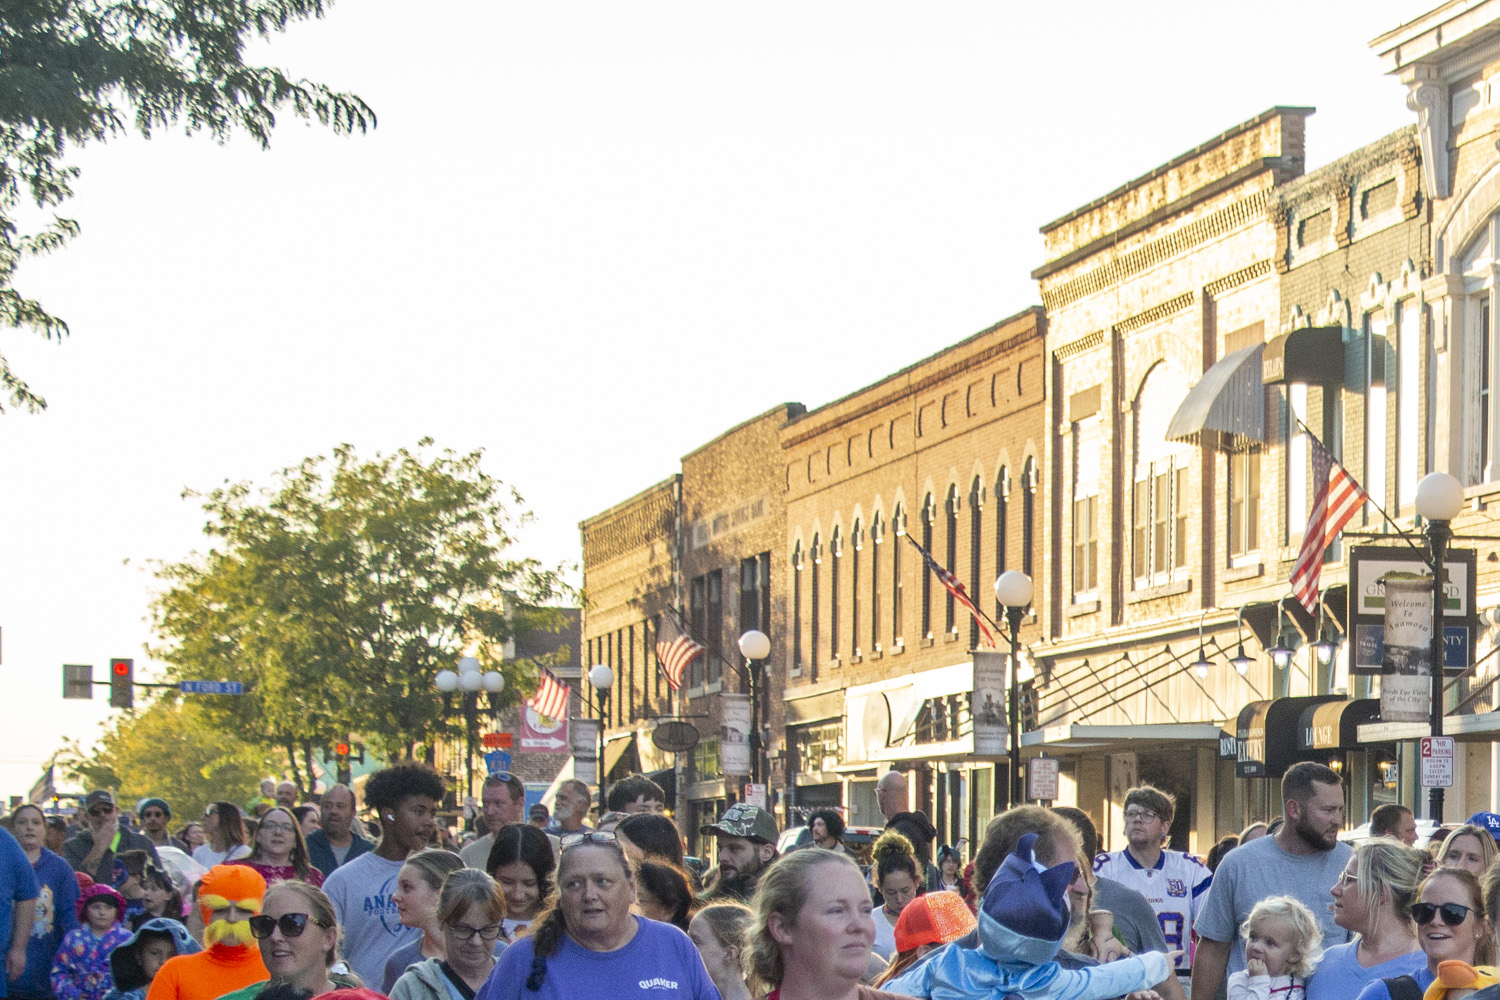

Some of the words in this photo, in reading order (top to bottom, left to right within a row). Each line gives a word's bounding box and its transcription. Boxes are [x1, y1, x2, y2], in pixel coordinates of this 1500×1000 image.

[1391, 600, 1427, 608] Welcome
[1389, 621, 1429, 632] Anamosa
[1305, 725, 1333, 746] LOUNGE
[1219, 737, 1236, 757] RESTA
[1237, 738, 1263, 763] EATERY
[1423, 742, 1431, 754] 2
[1486, 815, 1500, 828] LA
[638, 977, 679, 990] QUAKER
